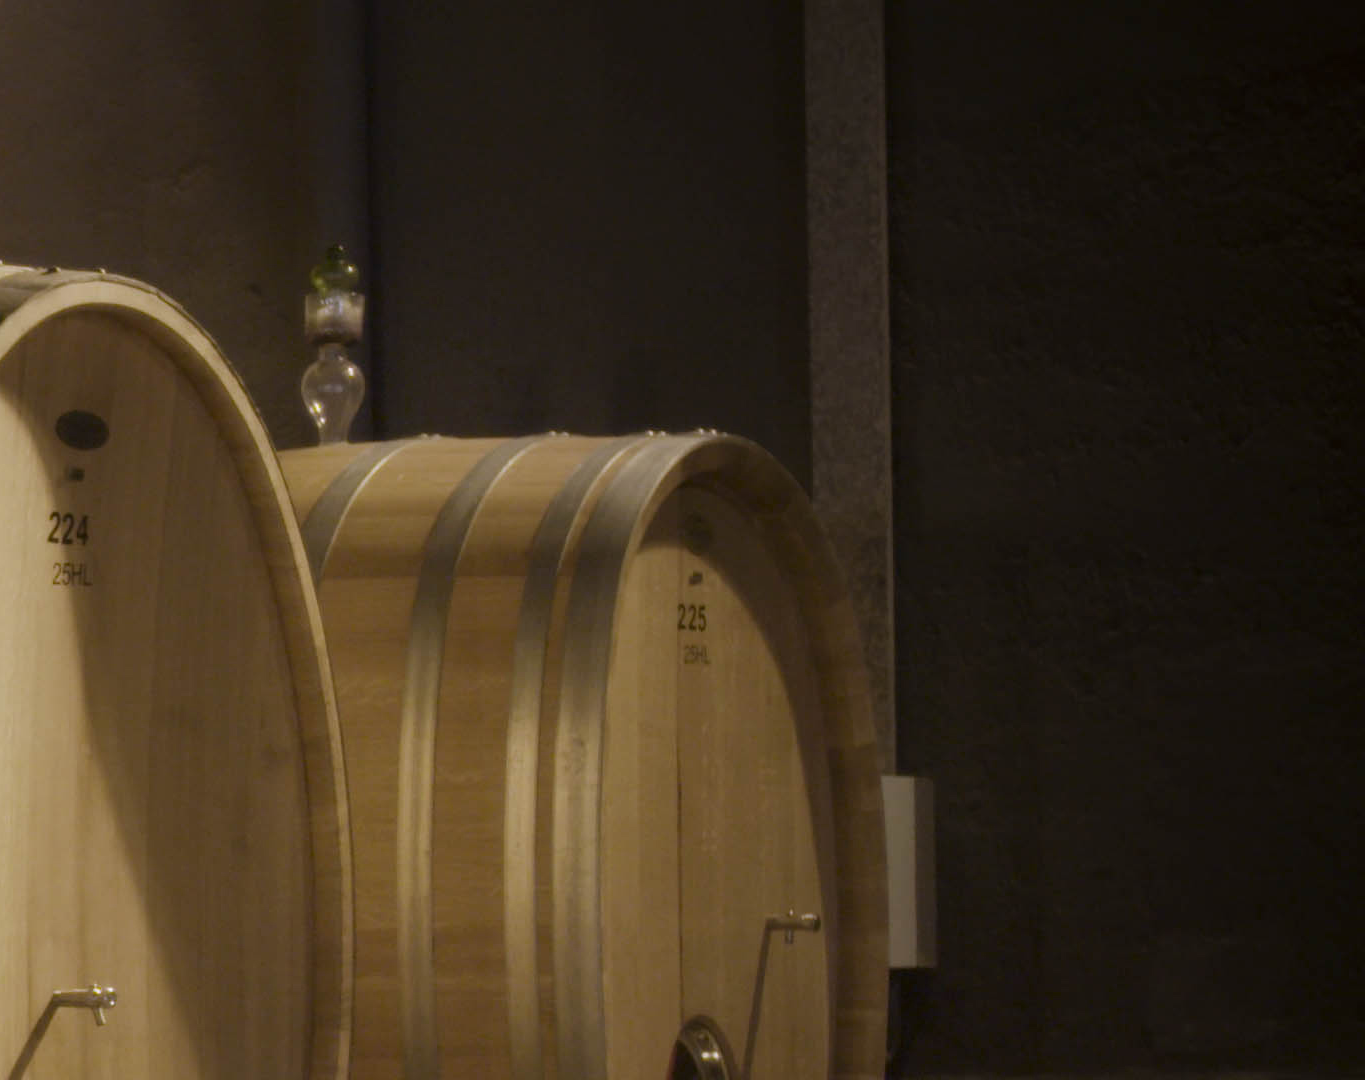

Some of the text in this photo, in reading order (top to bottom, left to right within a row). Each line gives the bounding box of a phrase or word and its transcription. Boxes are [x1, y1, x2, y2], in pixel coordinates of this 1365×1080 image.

[48, 511, 88, 546] 224
[52, 562, 93, 586] 25HL
[677, 603, 707, 632] 225
